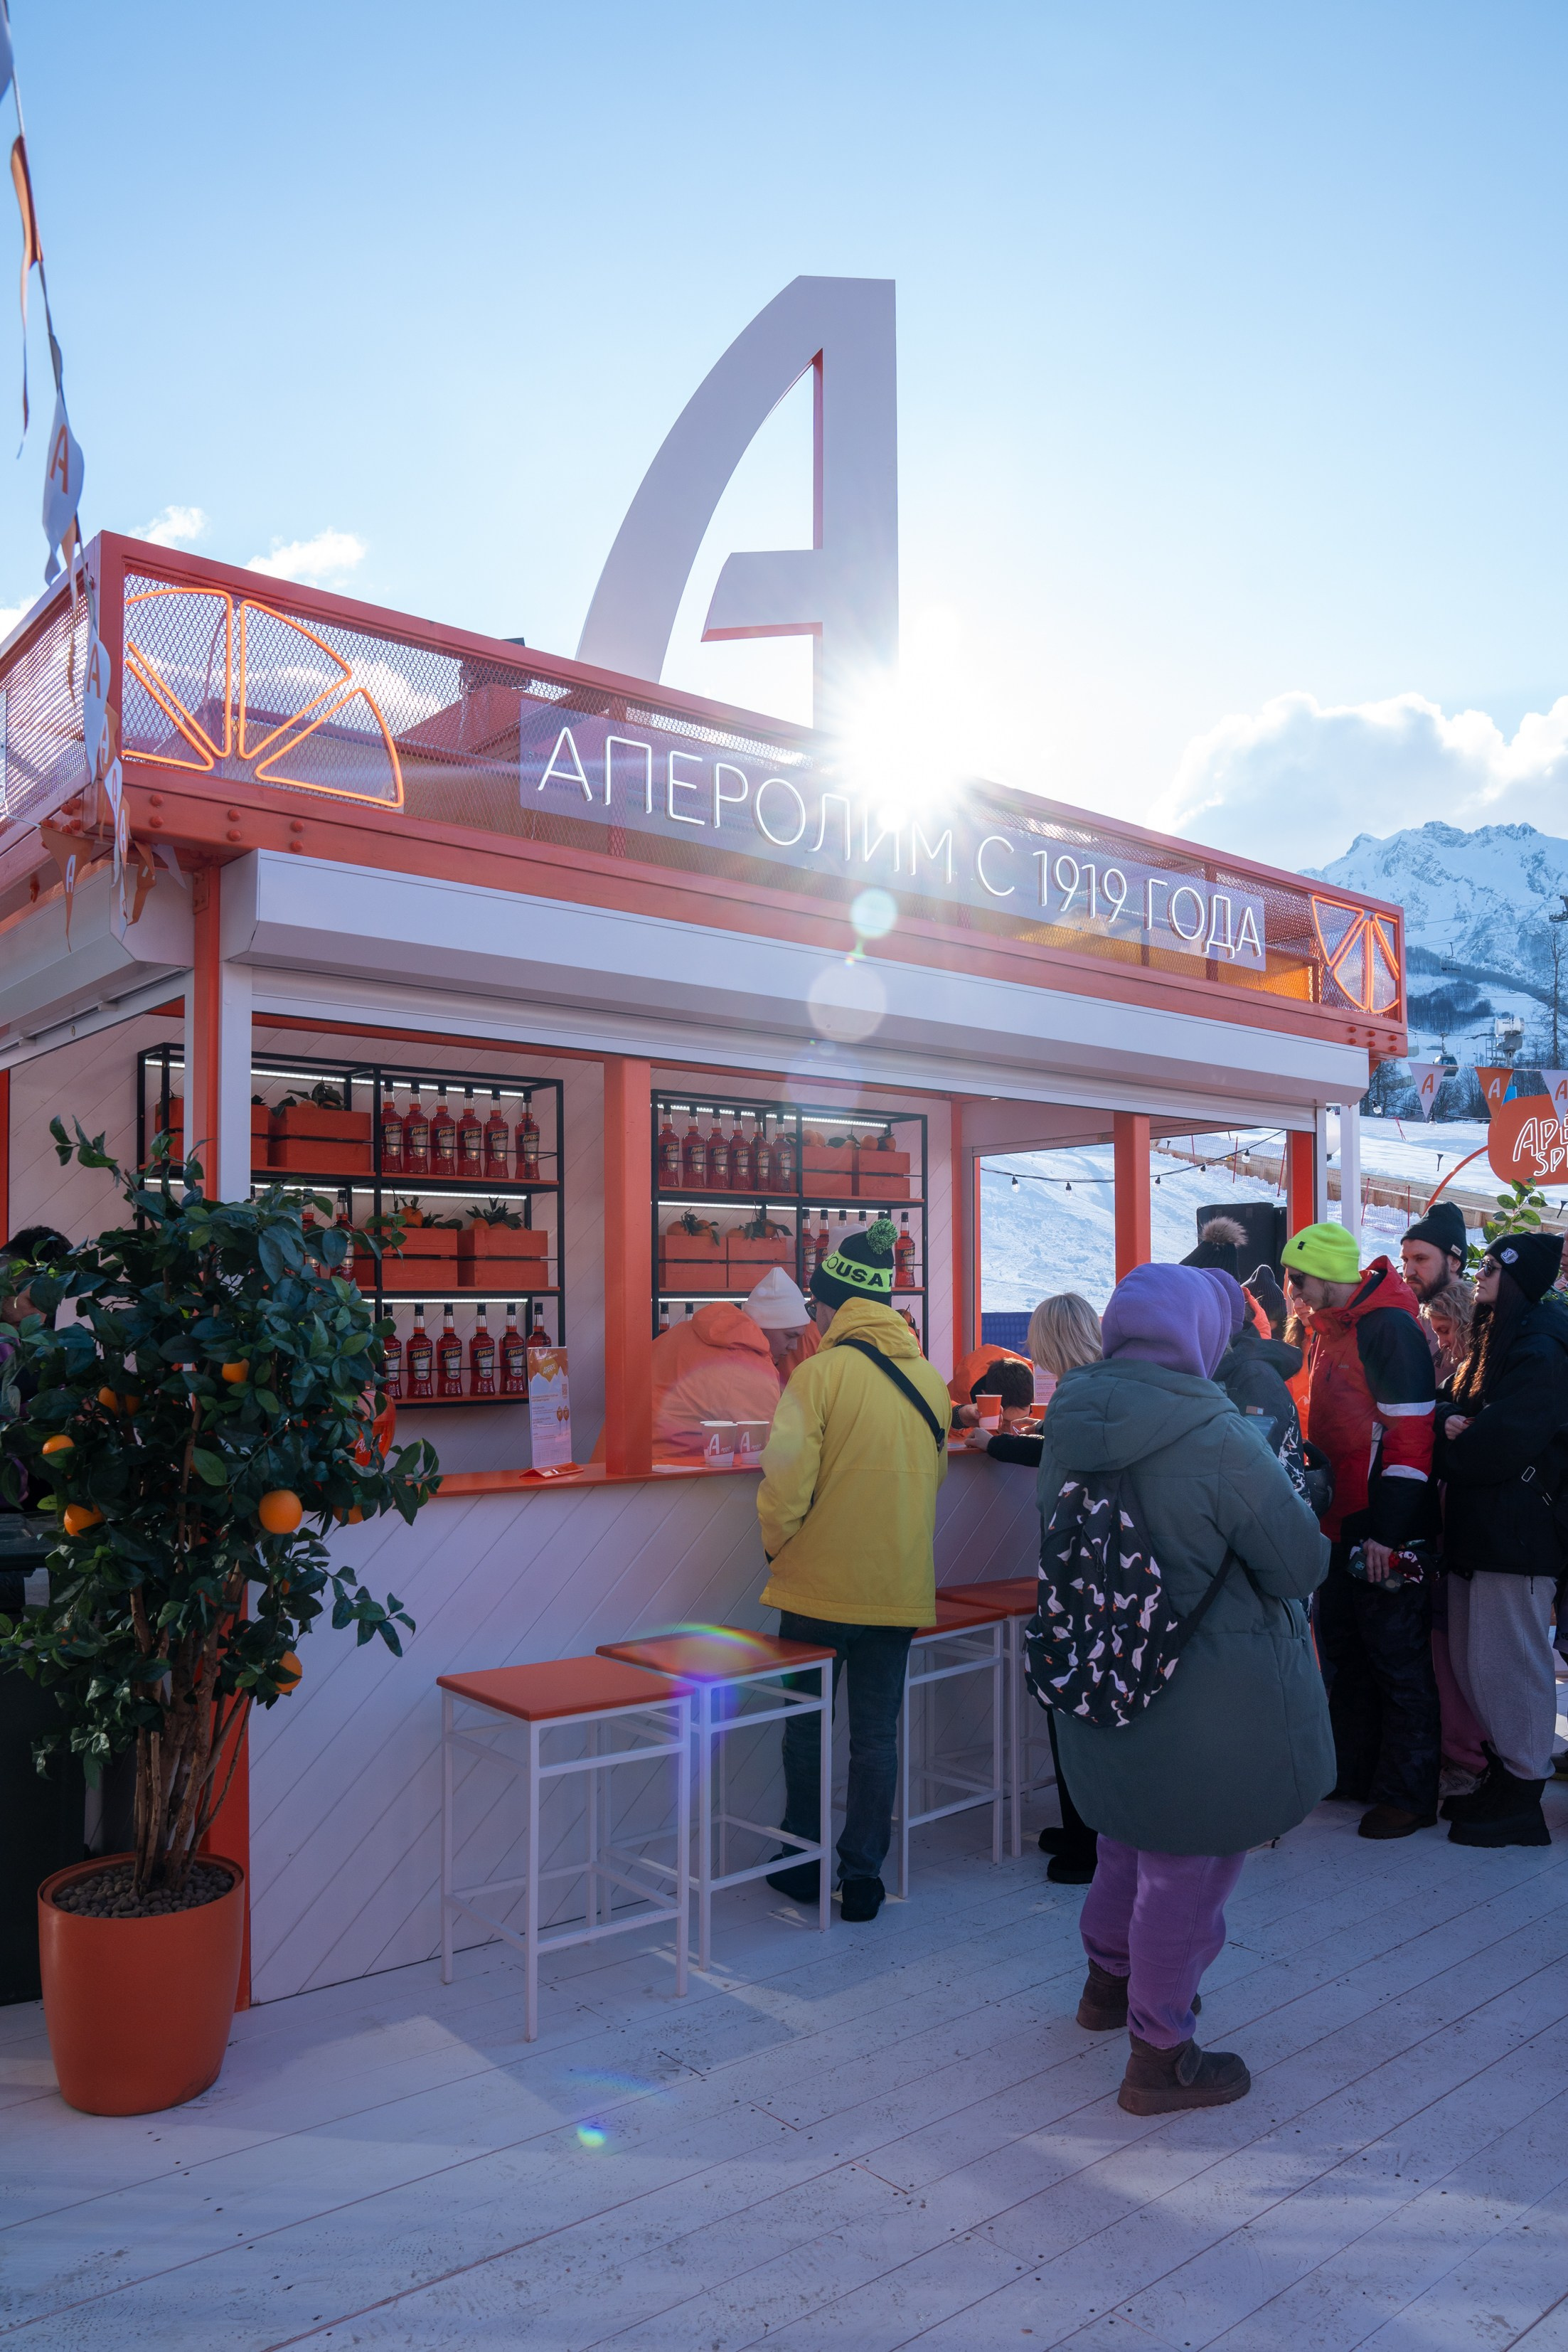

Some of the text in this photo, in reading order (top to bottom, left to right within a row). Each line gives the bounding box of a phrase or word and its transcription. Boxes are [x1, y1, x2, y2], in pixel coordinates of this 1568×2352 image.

[538, 727, 1262, 959] АПЕРОЛИМ С 1919 ГОДА
[1421, 1073, 1434, 1095] A
[1487, 1077, 1500, 1099] A
[836, 1260, 883, 1287] USA
